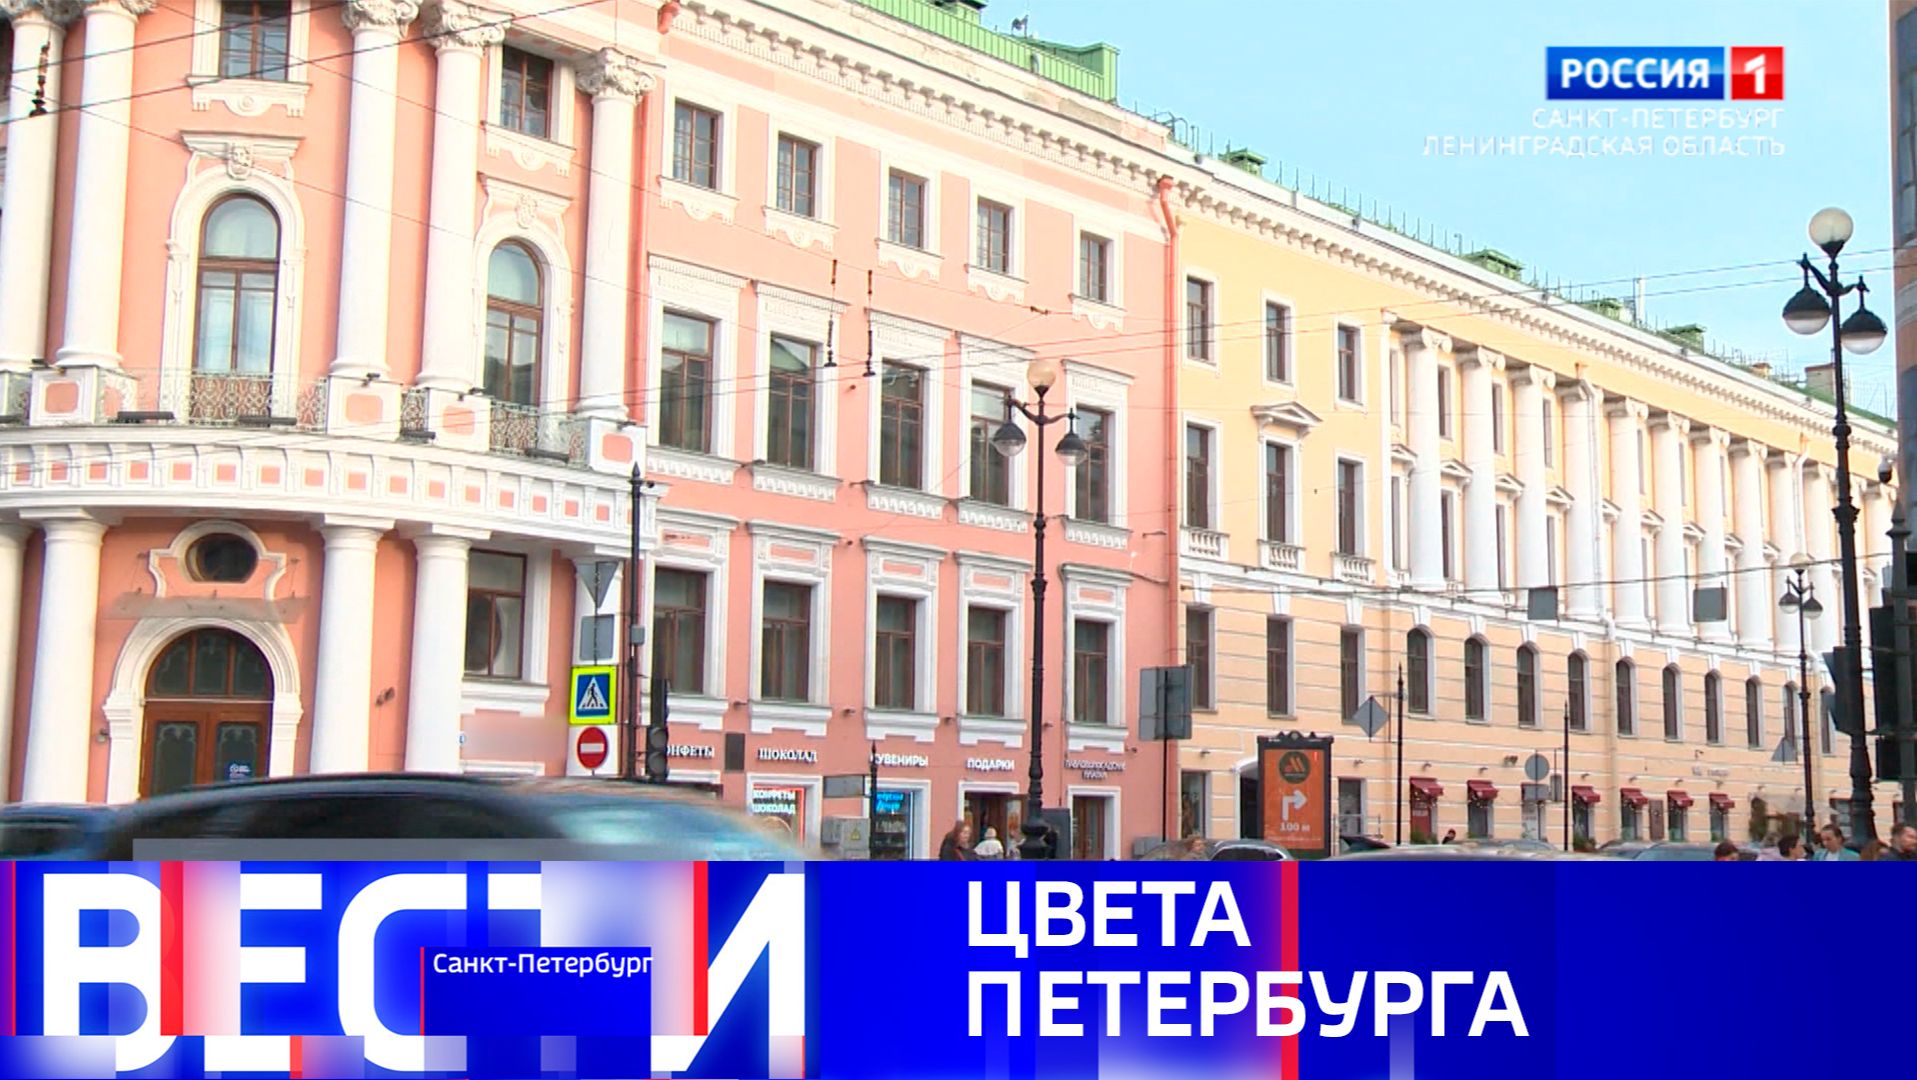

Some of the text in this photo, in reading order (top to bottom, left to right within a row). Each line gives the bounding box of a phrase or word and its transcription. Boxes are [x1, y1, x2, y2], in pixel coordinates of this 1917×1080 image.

[666, 745, 715, 758] НФЕТЫ
[759, 747, 818, 762] ШОКОЛАД
[870, 753, 928, 766] УВЕНИРЫ
[967, 757, 1015, 771] ПОДАРКИ
[1280, 822, 1299, 831] 100
